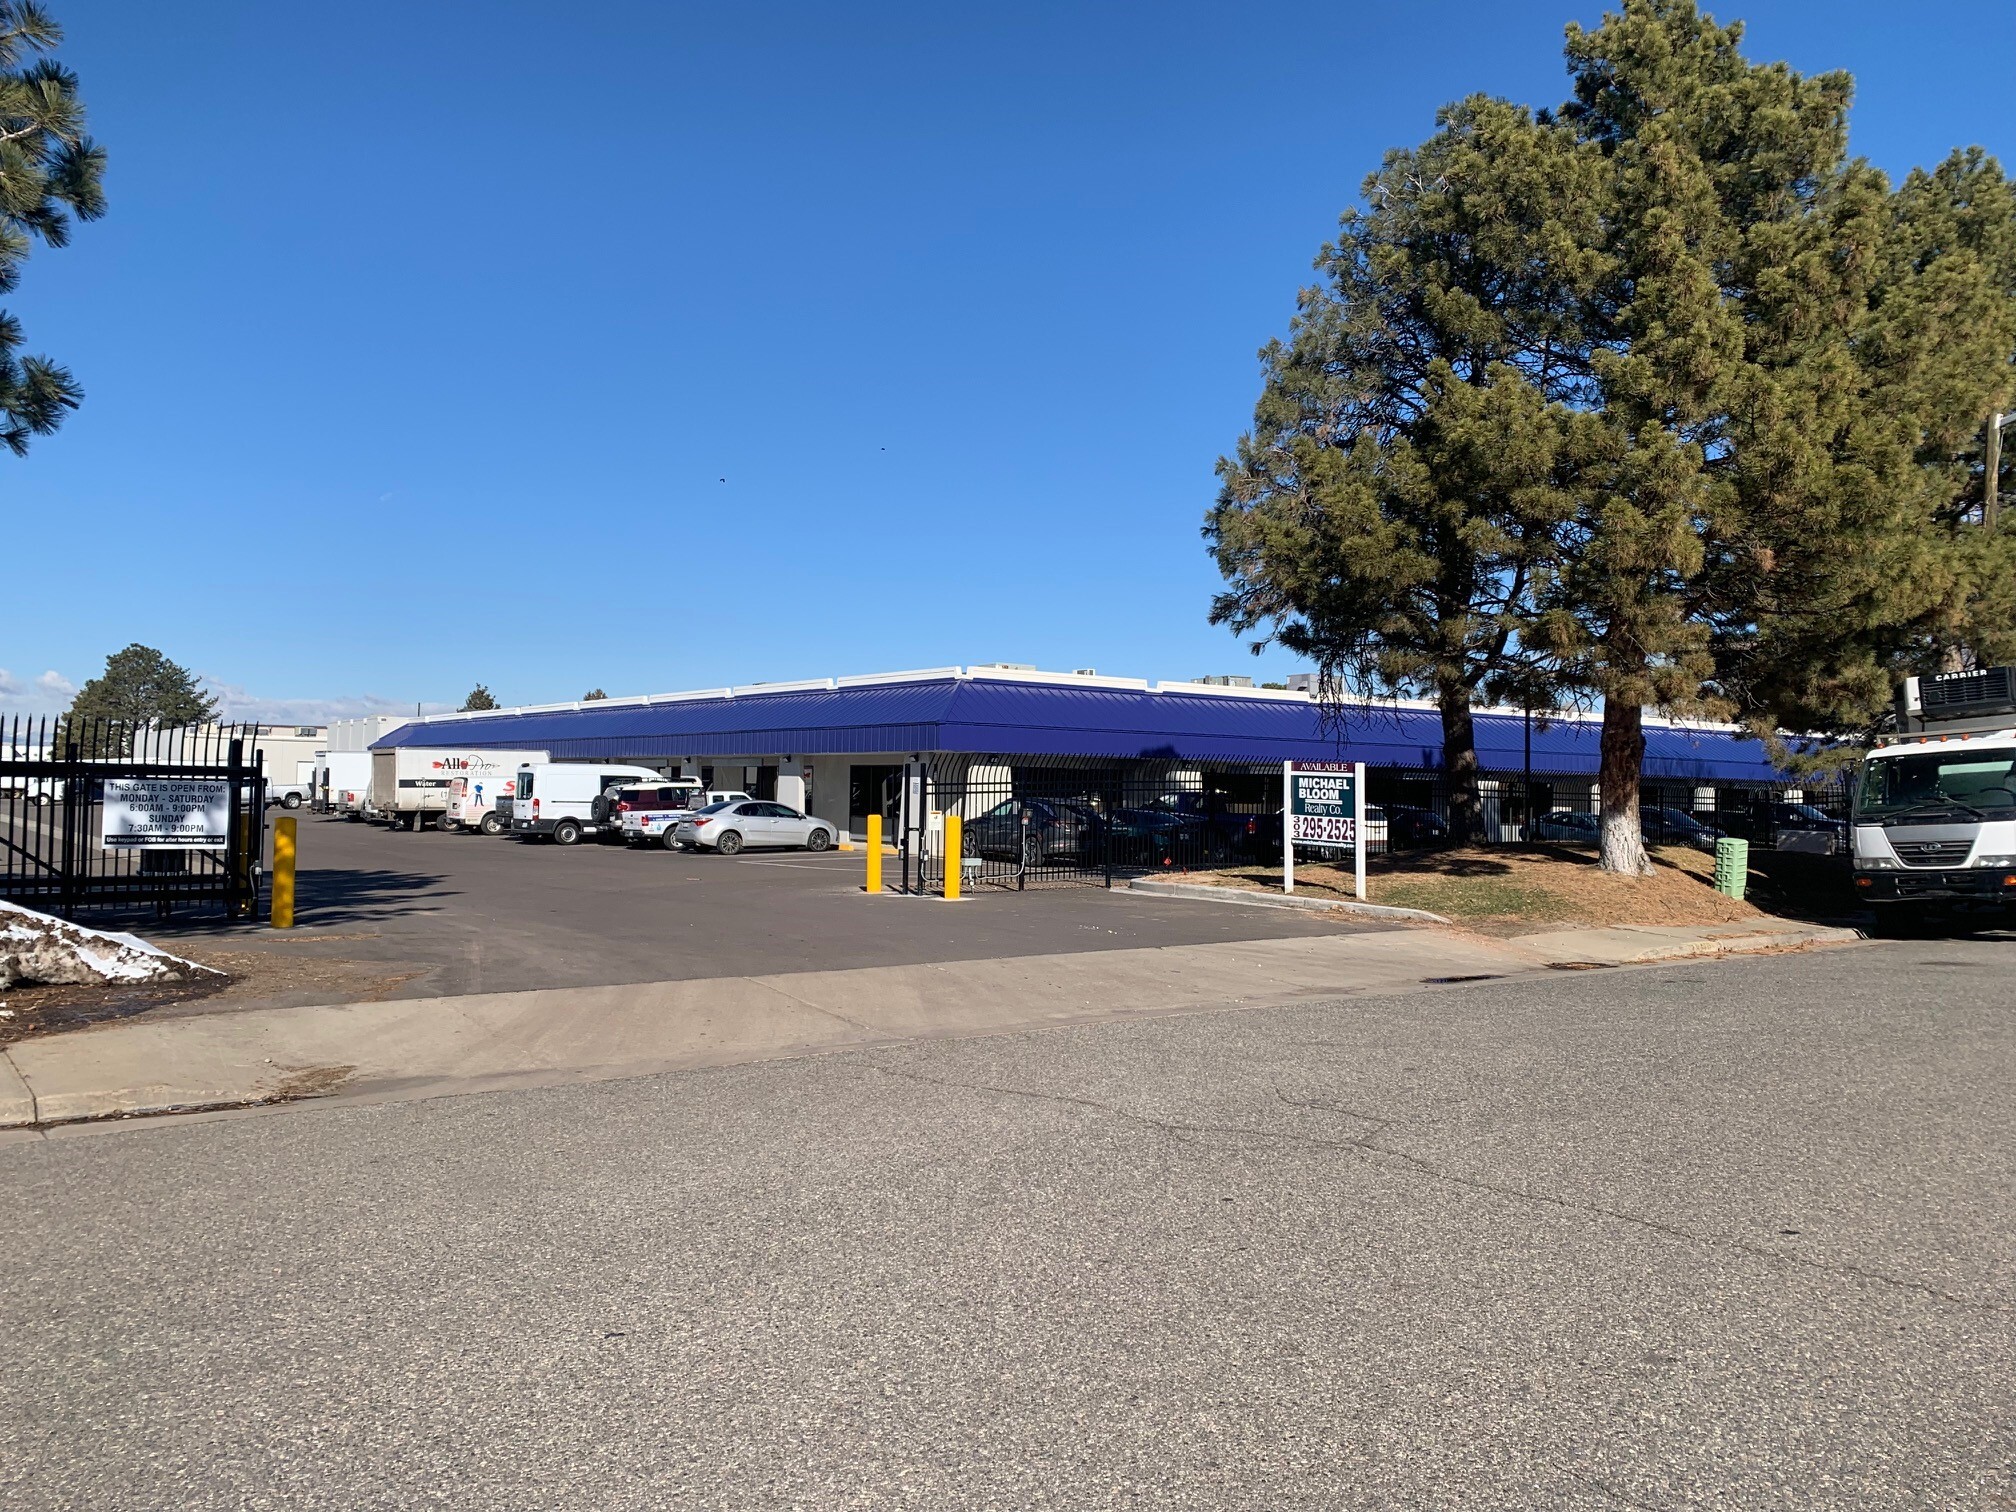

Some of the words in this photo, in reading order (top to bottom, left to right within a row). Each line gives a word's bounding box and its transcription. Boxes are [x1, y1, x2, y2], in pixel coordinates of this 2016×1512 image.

[1935, 669, 1988, 682] CARRIER
[442, 758, 460, 769] All
[1300, 763, 1348, 772] AVAILABLE
[109, 783, 130, 792] THIS
[132, 783, 157, 792] GATE
[159, 784, 168, 792] IS
[170, 784, 195, 793] OPEN
[197, 784, 226, 793] FROM:
[1298, 777, 1350, 790] MICHAEL
[120, 793, 160, 803] MONDAY
[168, 794, 215, 804] SATURDAY
[1298, 788, 1340, 800] BLOOM
[129, 803, 164, 812] 6:00AM
[172, 804, 205, 813] 9:00PM
[1304, 803, 1328, 816] Realty
[1329, 804, 1343, 815] Co.
[148, 814, 186, 823] SUNDAY
[128, 824, 163, 832] 7:30AM
[171, 824, 204, 833] 9:00PM
[1293, 815, 1301, 838] 303
[1302, 817, 1356, 842] 295-2525
